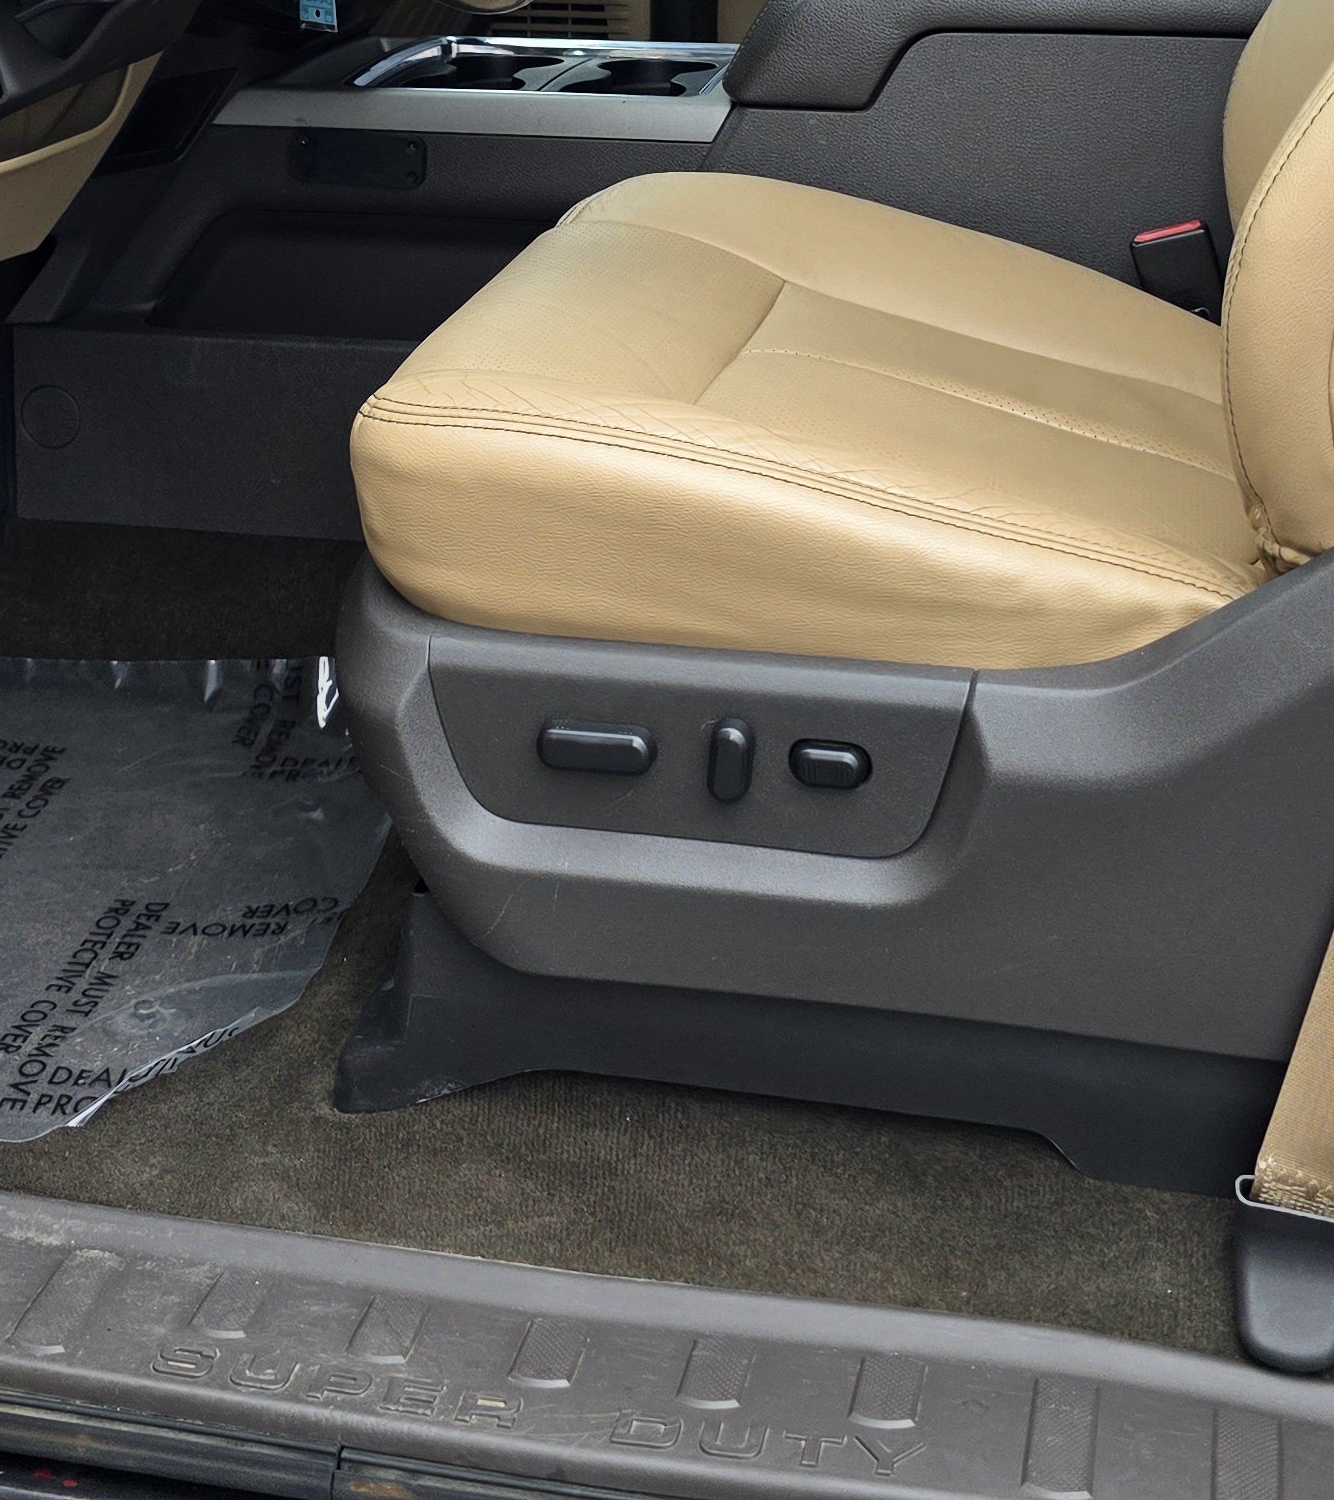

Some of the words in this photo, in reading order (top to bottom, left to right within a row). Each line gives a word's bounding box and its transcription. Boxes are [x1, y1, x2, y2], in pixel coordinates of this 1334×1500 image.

[0, 745, 66, 800] REMOVE
[17, 776, 71, 820] COVER
[110, 901, 170, 962] DEALER
[158, 919, 290, 938] REMOVE
[241, 896, 340, 920] COVER
[45, 899, 134, 994] PROTECTIVE
[66, 971, 119, 1018] MUST
[151, 1345, 524, 1429] SUPER
[610, 1409, 927, 1477] DUTY
